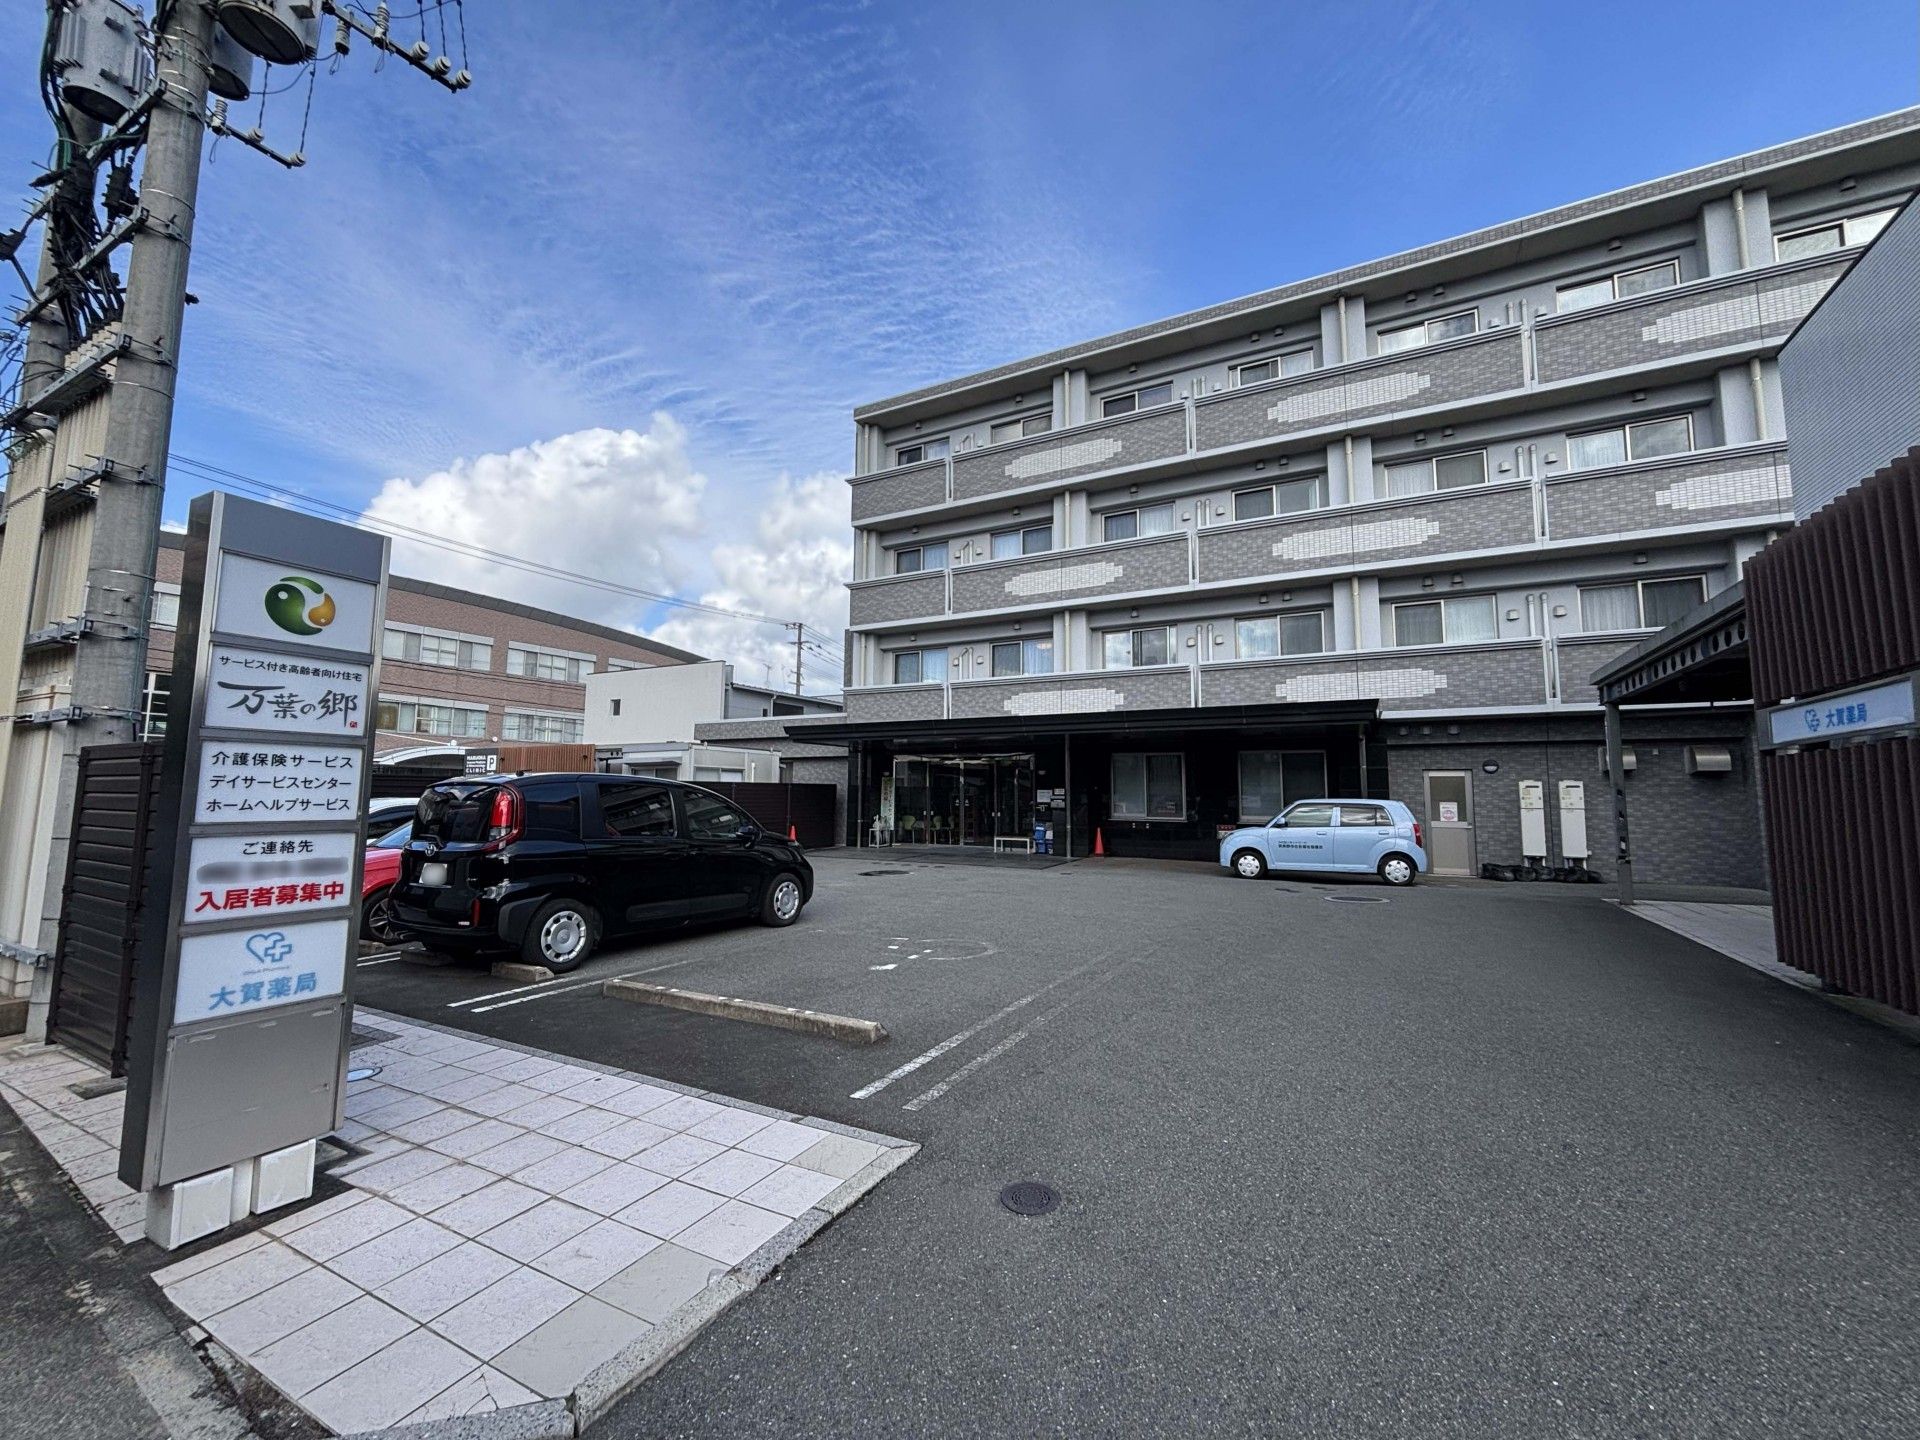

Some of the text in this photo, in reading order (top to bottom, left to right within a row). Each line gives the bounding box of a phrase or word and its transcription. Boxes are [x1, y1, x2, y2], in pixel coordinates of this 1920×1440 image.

[219, 655, 362, 682] サービス付き高齢者向け住宅
[217, 680, 358, 728] 万葉の郷
[211, 751, 353, 769] 介護保険サービス
[209, 775, 352, 790] デイサービスセンター
[206, 797, 350, 812] ホームヘルプサービス
[242, 840, 314, 855] ご連絡先
[195, 881, 344, 913] 入居者募集中
[208, 971, 317, 1011] 大賀薬局
